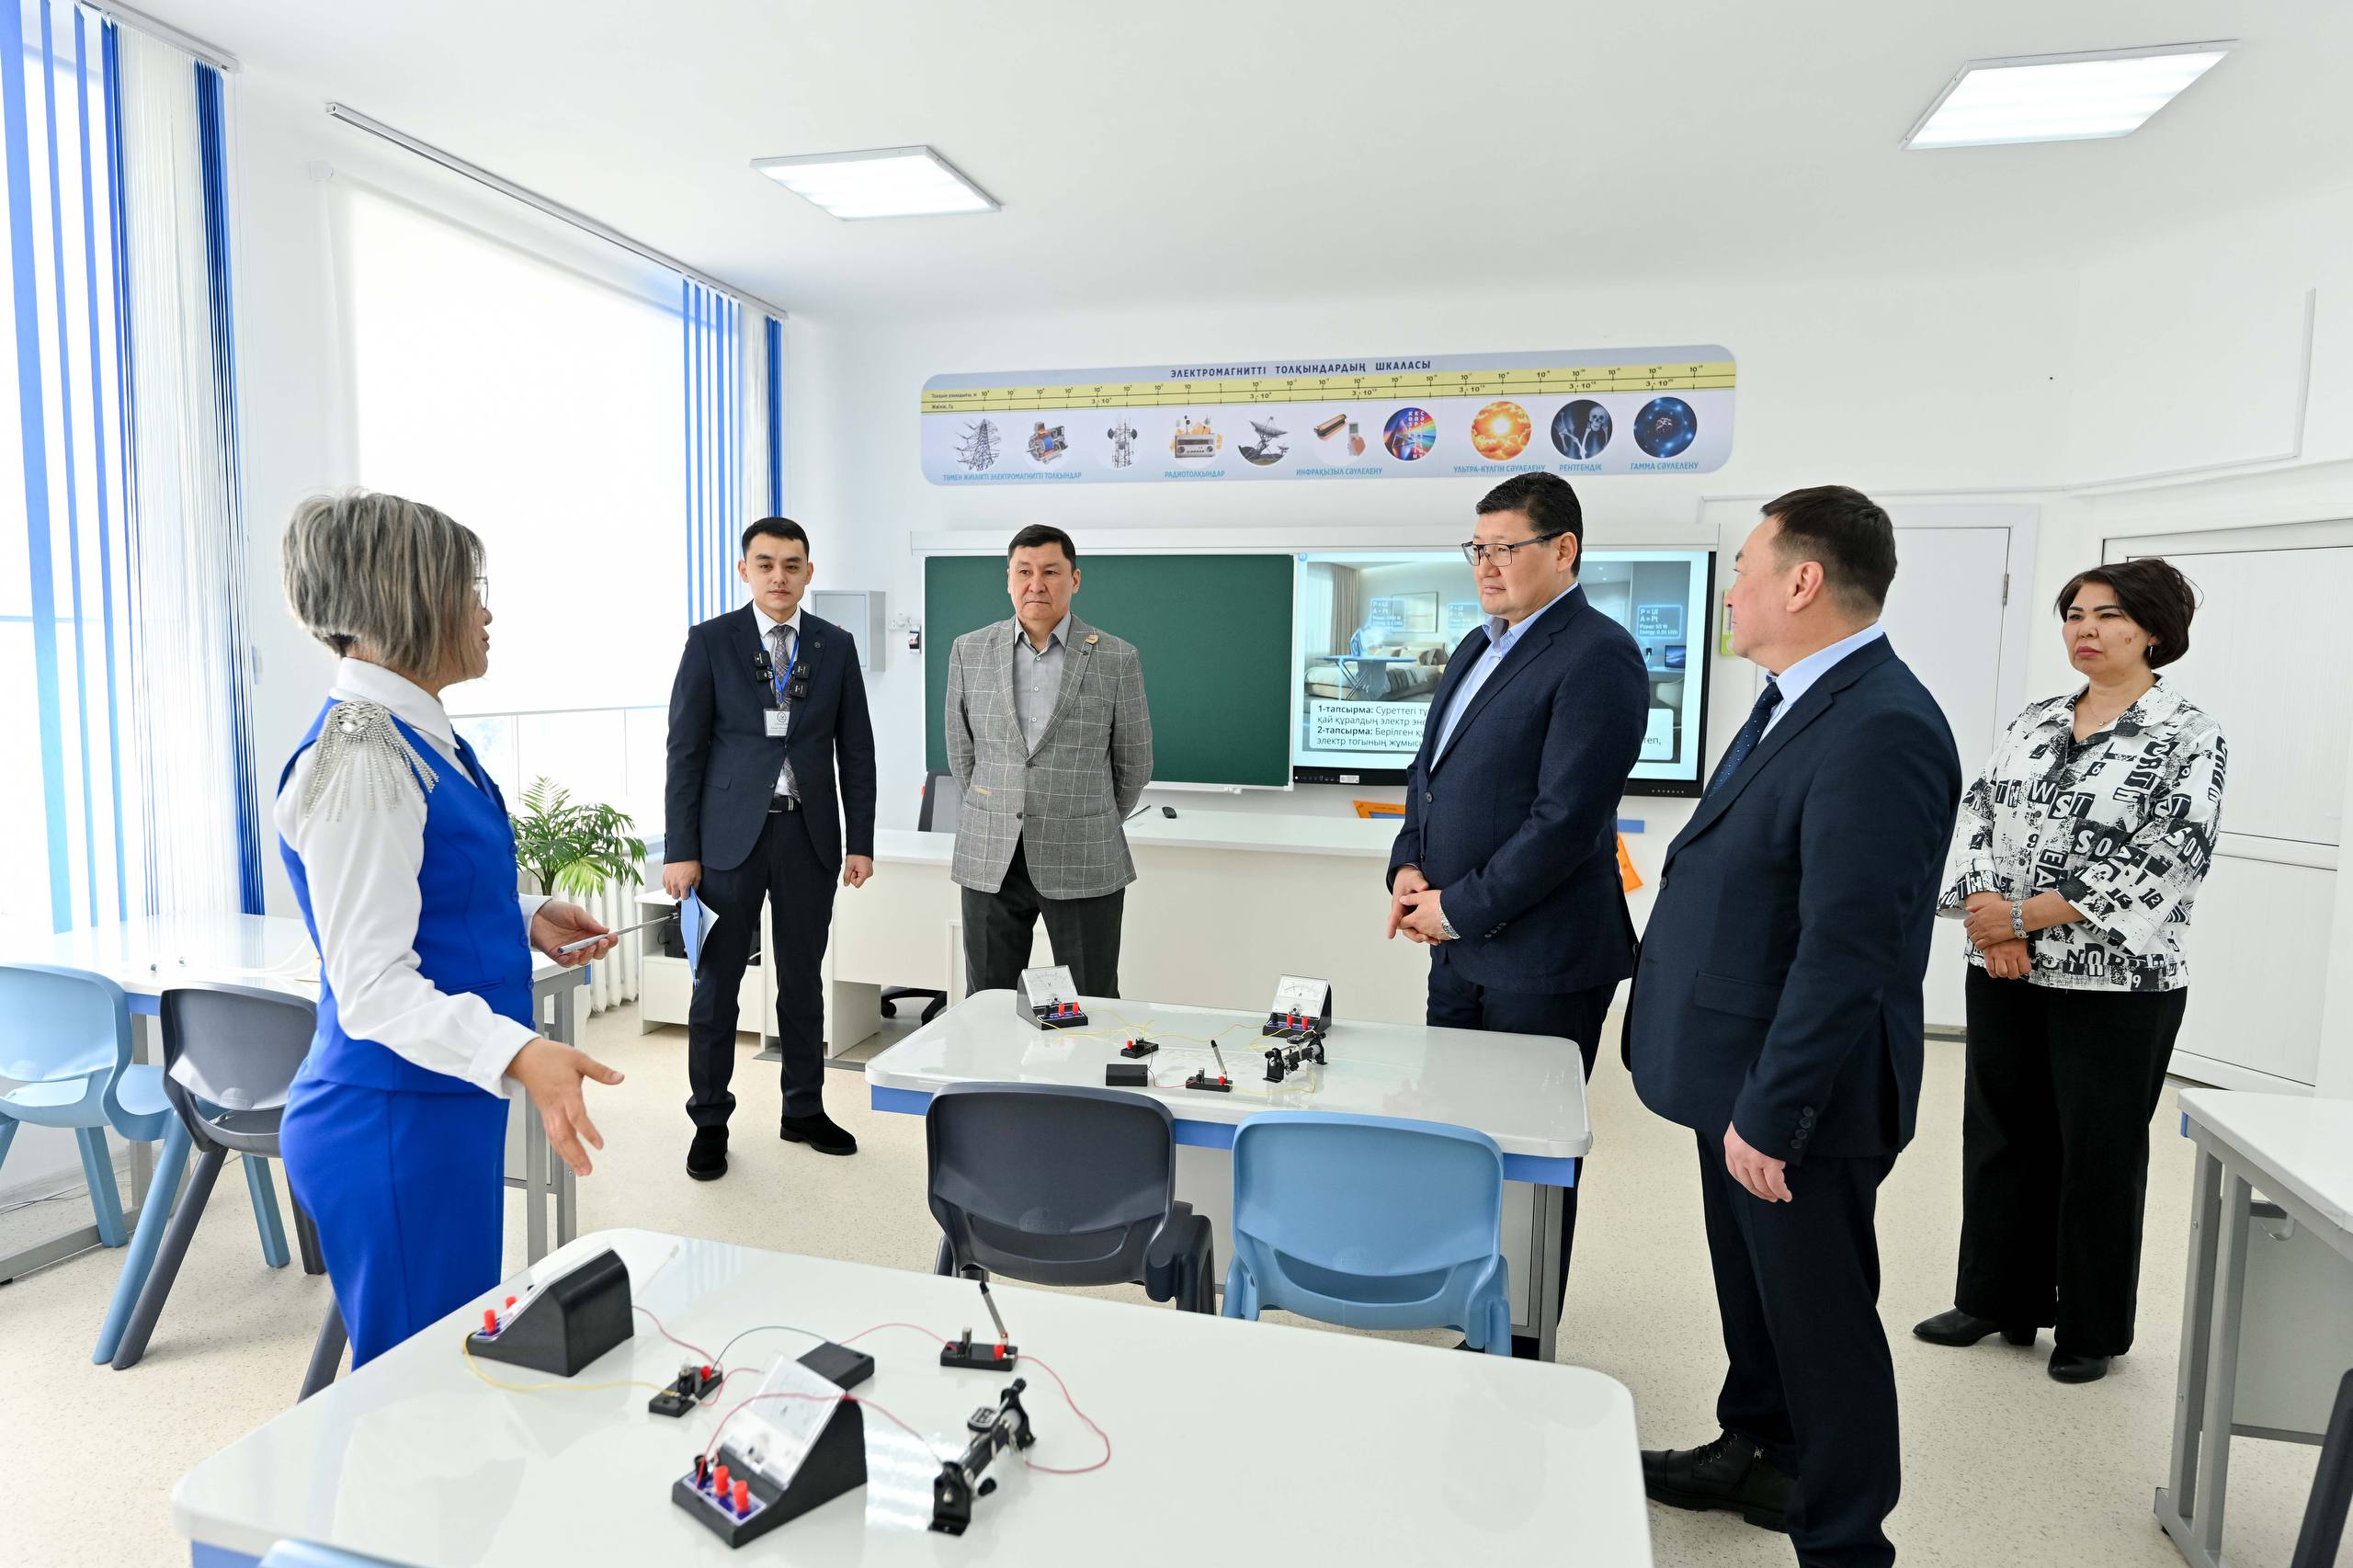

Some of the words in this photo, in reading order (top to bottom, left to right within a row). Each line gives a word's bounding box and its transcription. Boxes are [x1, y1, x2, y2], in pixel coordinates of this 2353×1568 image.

[1171, 366, 1266, 378] ЭЛЕКТРОМАГНИТТІ
[1276, 362, 1366, 375] ТОЛҚЫНДАРДЫҢ
[1375, 360, 1431, 370] ШКАЛАСЫ
[1506, 464, 1546, 472] СӘУЛЕЛЕНУ
[1559, 463, 1602, 472] РЕНТГЕНДІК
[1631, 462, 1654, 471] ГАММА
[1656, 461, 1699, 470] СӘУЛЕЛЕНУ
[1164, 471, 1226, 479] РАДИОТОЛҚЫНДАР
[1296, 467, 1344, 476] ИНФРАҚЫЗЫЛ
[1346, 467, 1382, 475] СӘУЛЕЛЕНУ
[1318, 705, 1373, 714] 1-тапсырма:
[1376, 706, 1415, 716] Суреттегі
[1318, 715, 1333, 724] қай
[1381, 719, 1410, 727] электр
[1317, 726, 1372, 735] 2-тапсырма:
[1375, 728, 1413, 737] Берілген
[1317, 738, 1346, 746] электр
